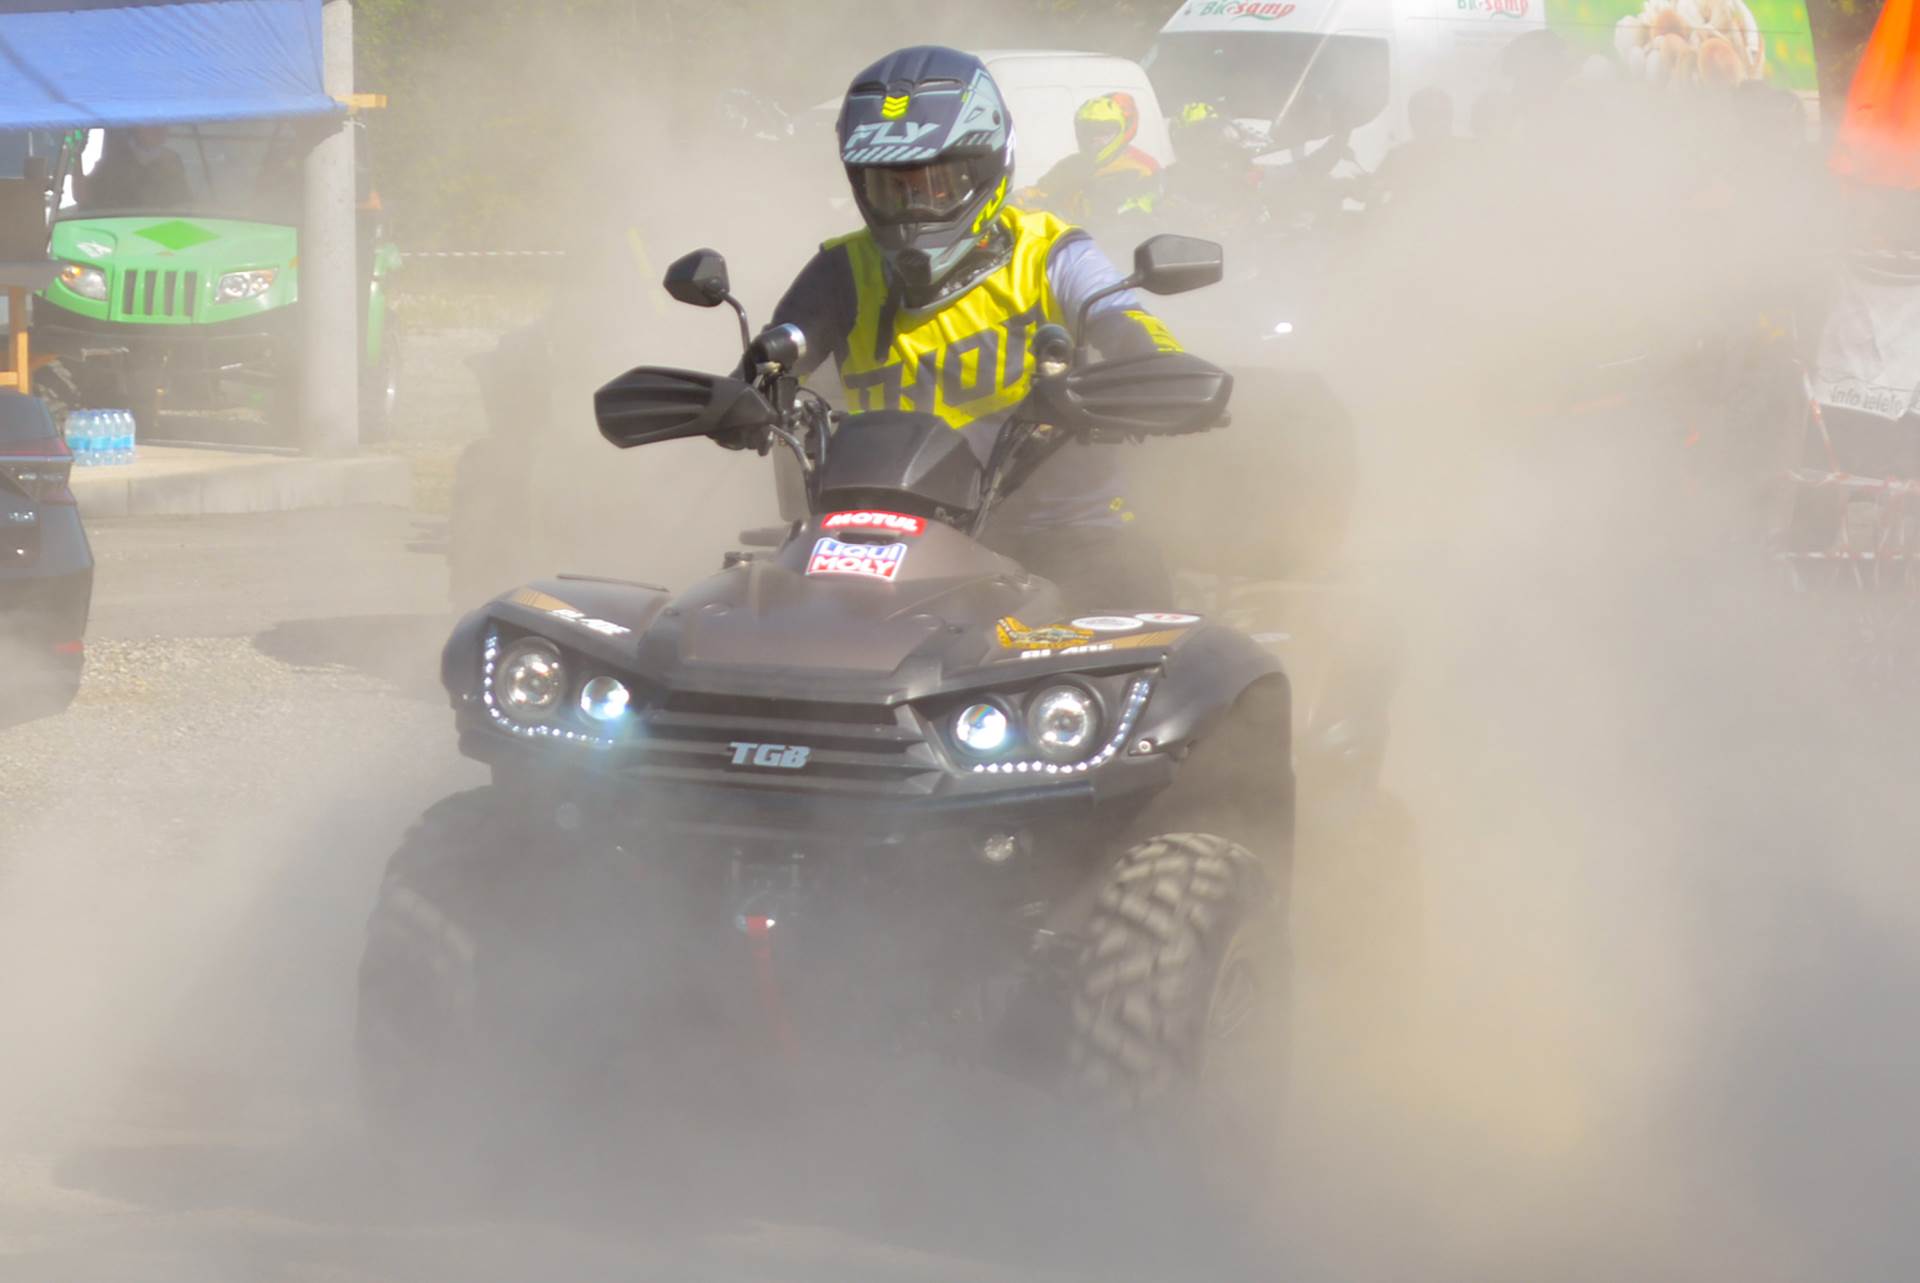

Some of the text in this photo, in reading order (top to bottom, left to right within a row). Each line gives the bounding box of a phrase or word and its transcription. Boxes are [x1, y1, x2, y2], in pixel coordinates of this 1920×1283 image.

[843, 121, 941, 149] FLY
[971, 176, 1008, 235] FLY
[825, 512, 919, 532] MOTUL
[817, 540, 901, 560] LIQUI
[810, 554, 897, 577] MOLY
[729, 741, 811, 768] TGB
